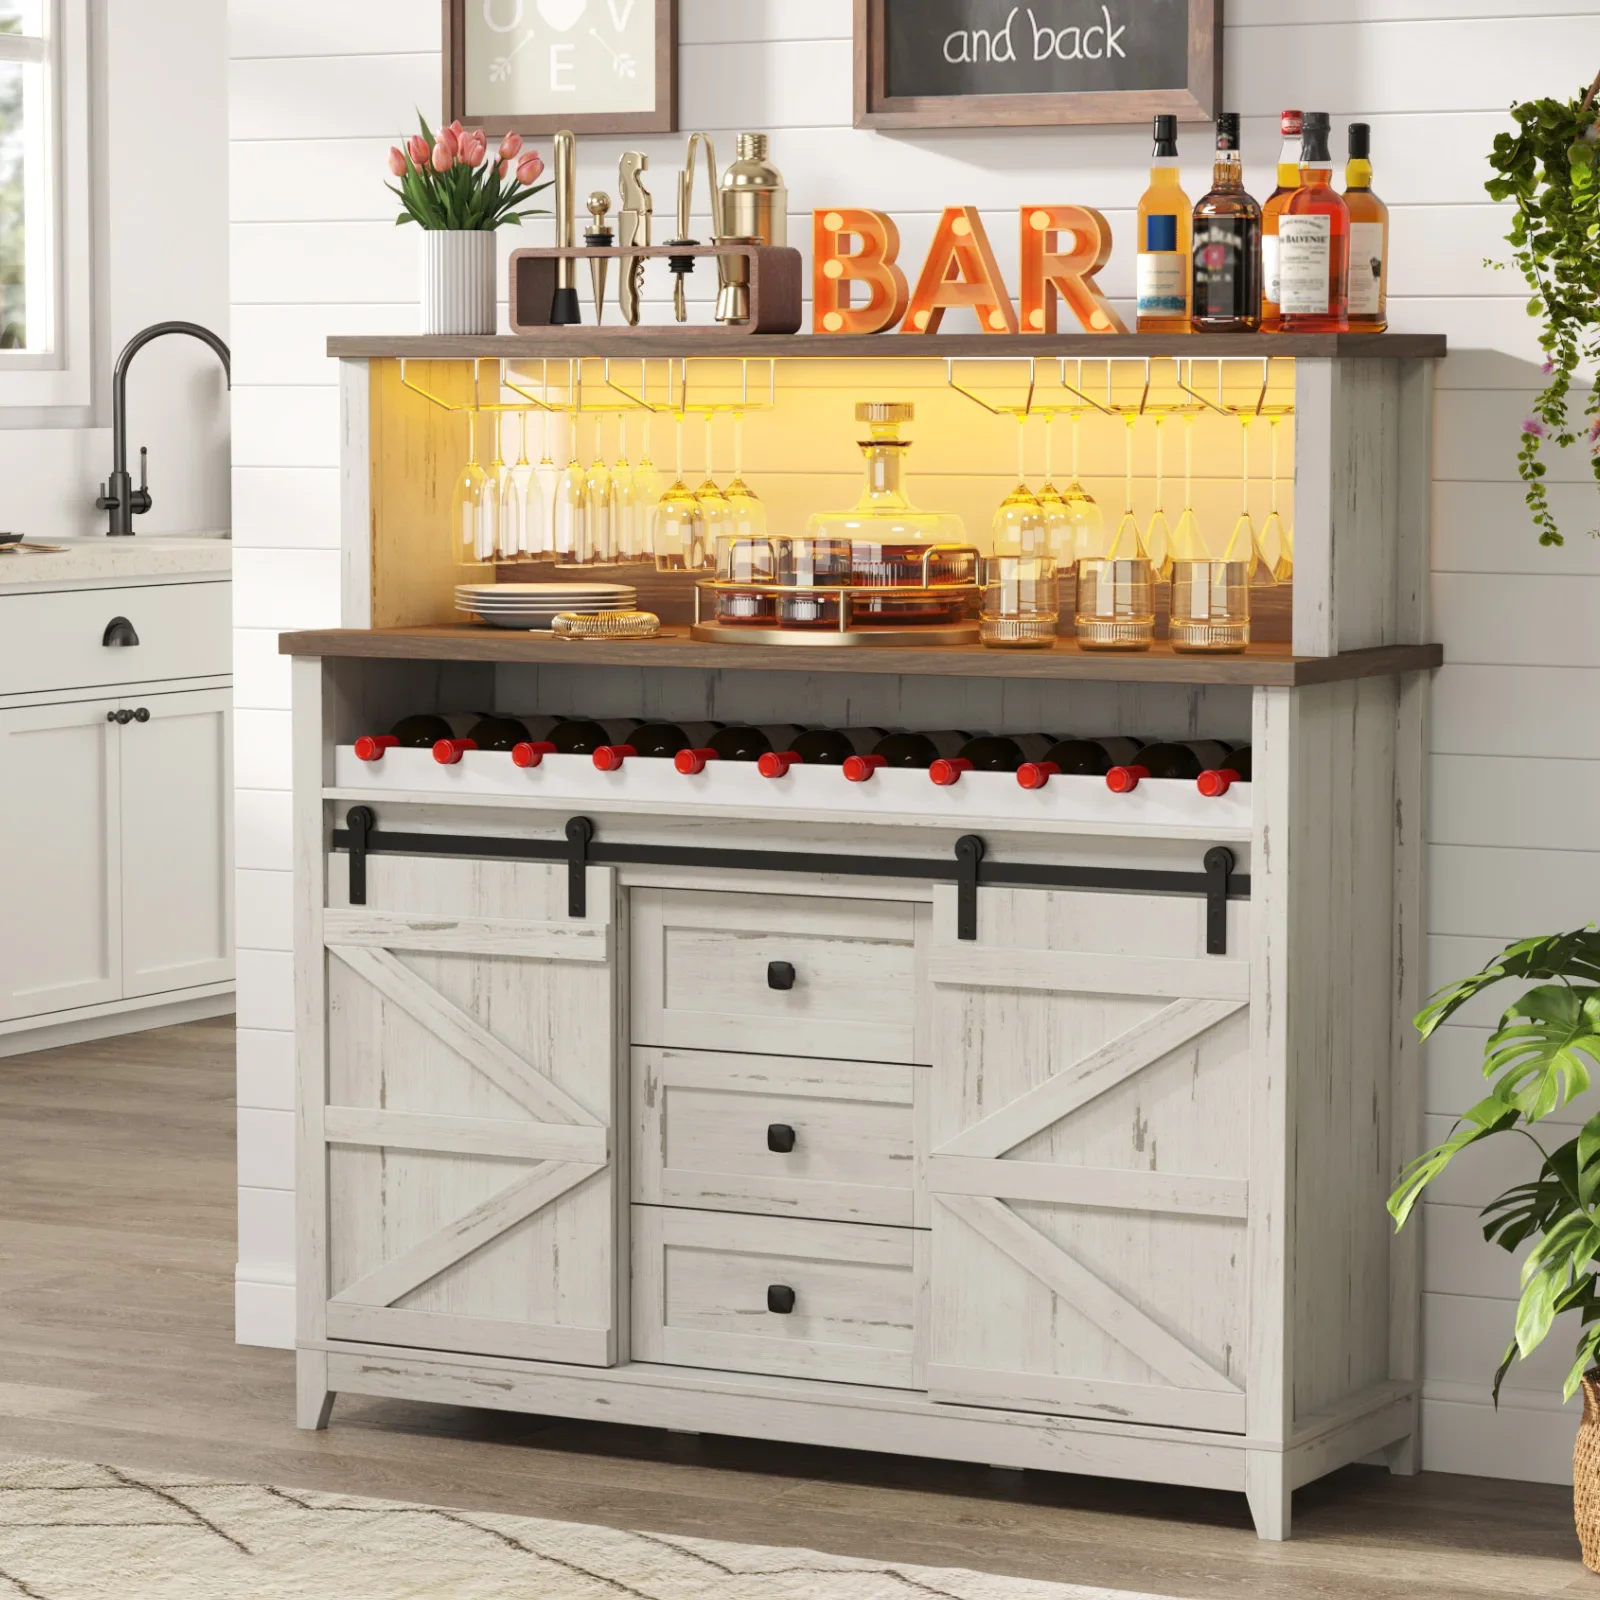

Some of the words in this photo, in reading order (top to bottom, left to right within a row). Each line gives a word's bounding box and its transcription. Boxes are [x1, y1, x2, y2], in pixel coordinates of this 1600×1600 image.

[943, 6, 1018, 64] and
[1026, 4, 1127, 62] back
[549, 43, 577, 92] E
[811, 204, 1130, 335] BAR
